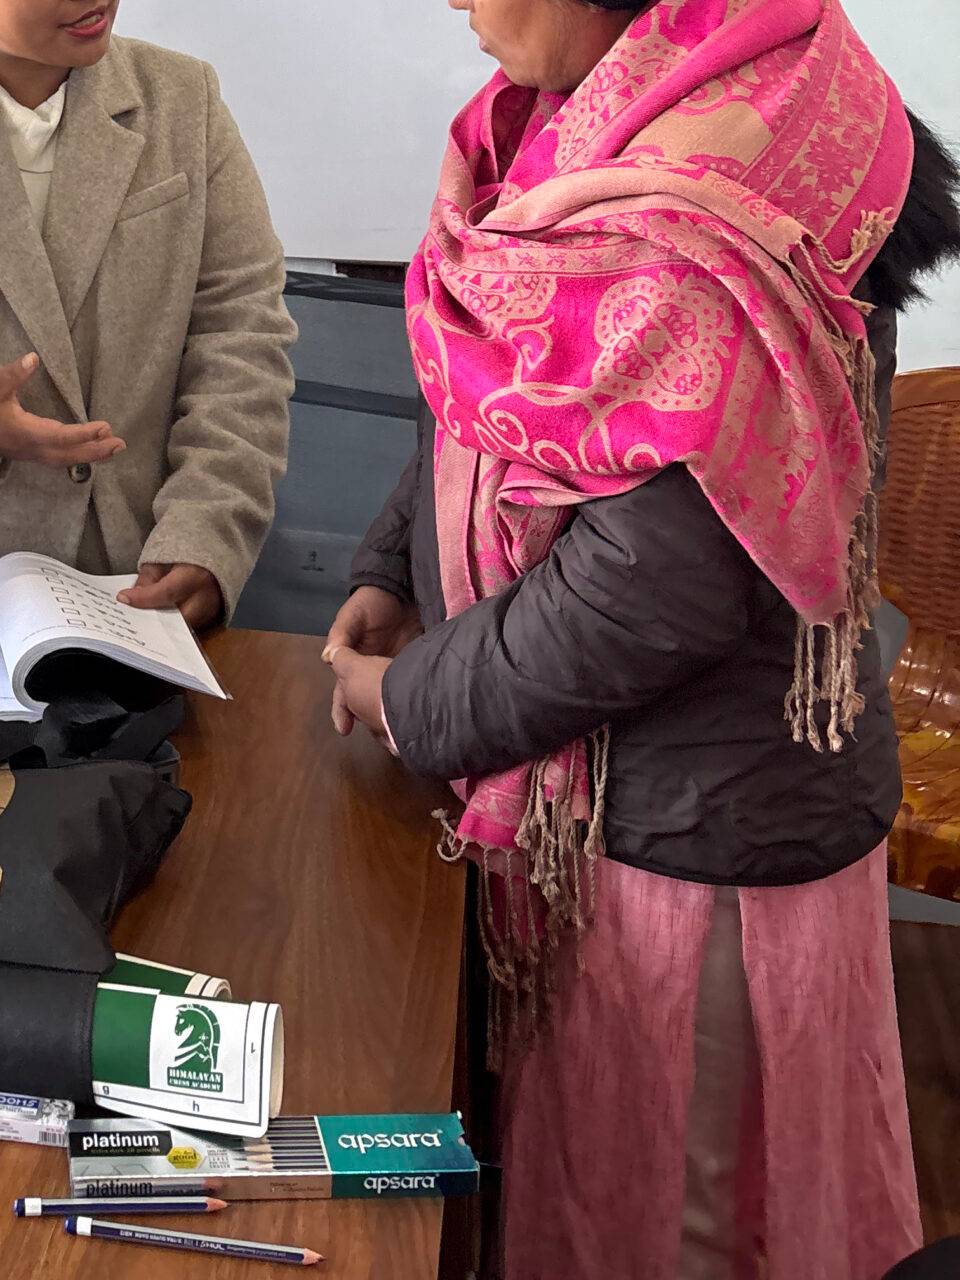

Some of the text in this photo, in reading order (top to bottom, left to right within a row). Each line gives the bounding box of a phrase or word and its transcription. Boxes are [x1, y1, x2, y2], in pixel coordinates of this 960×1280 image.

[168, 1068, 222, 1084] HIMALAYAN
[192, 1100, 200, 1113] h
[82, 1133, 159, 1151] platinum
[337, 1131, 442, 1154] apsara
[86, 1180, 153, 1198] platinum
[363, 1175, 436, 1194] apsara
